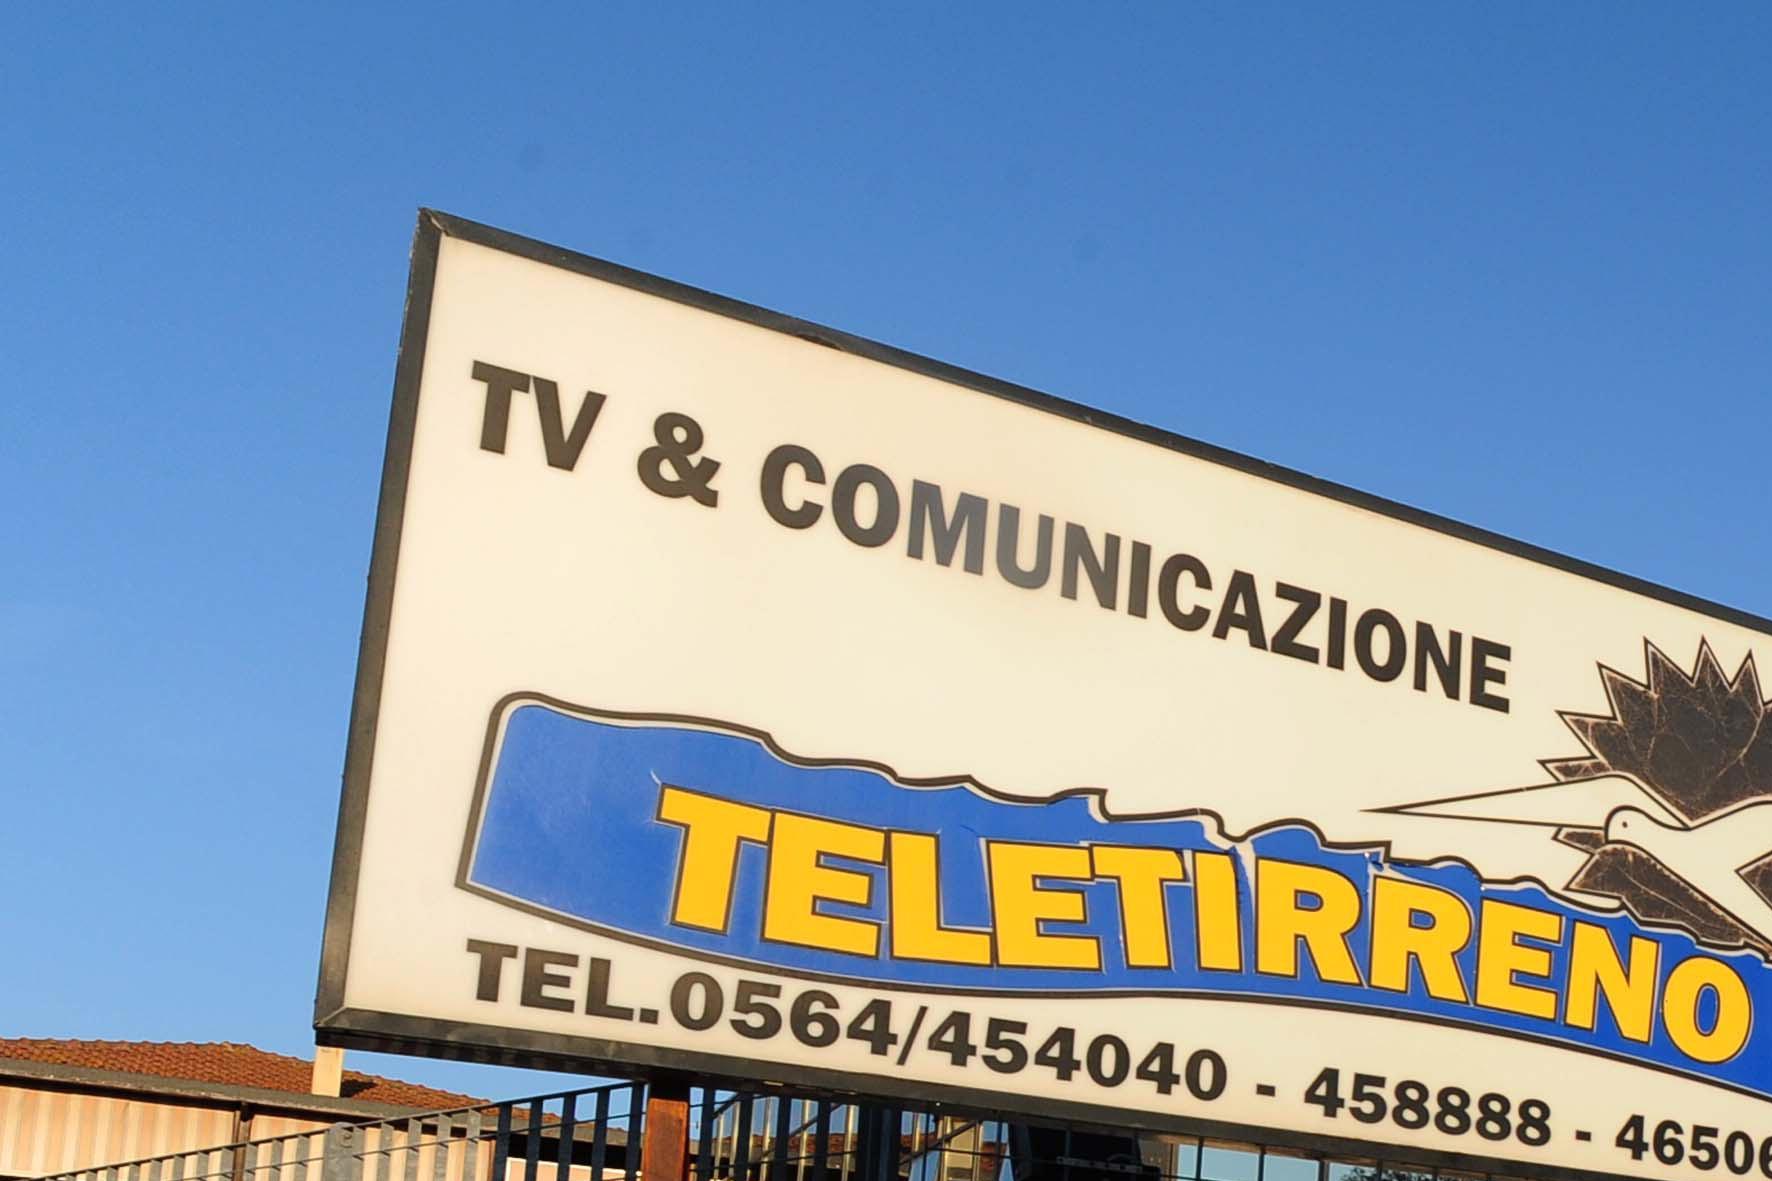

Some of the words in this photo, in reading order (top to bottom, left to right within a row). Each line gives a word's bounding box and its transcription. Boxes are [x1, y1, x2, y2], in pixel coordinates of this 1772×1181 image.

[472, 361, 606, 471] TV
[638, 413, 720, 507] &
[761, 445, 1511, 714] COMUNICAZIONE
[467, 939, 1227, 1101] TEL.0564/454040
[1304, 1068, 1551, 1146] 458888
[660, 786, 1751, 1064] TELETIRRENO
